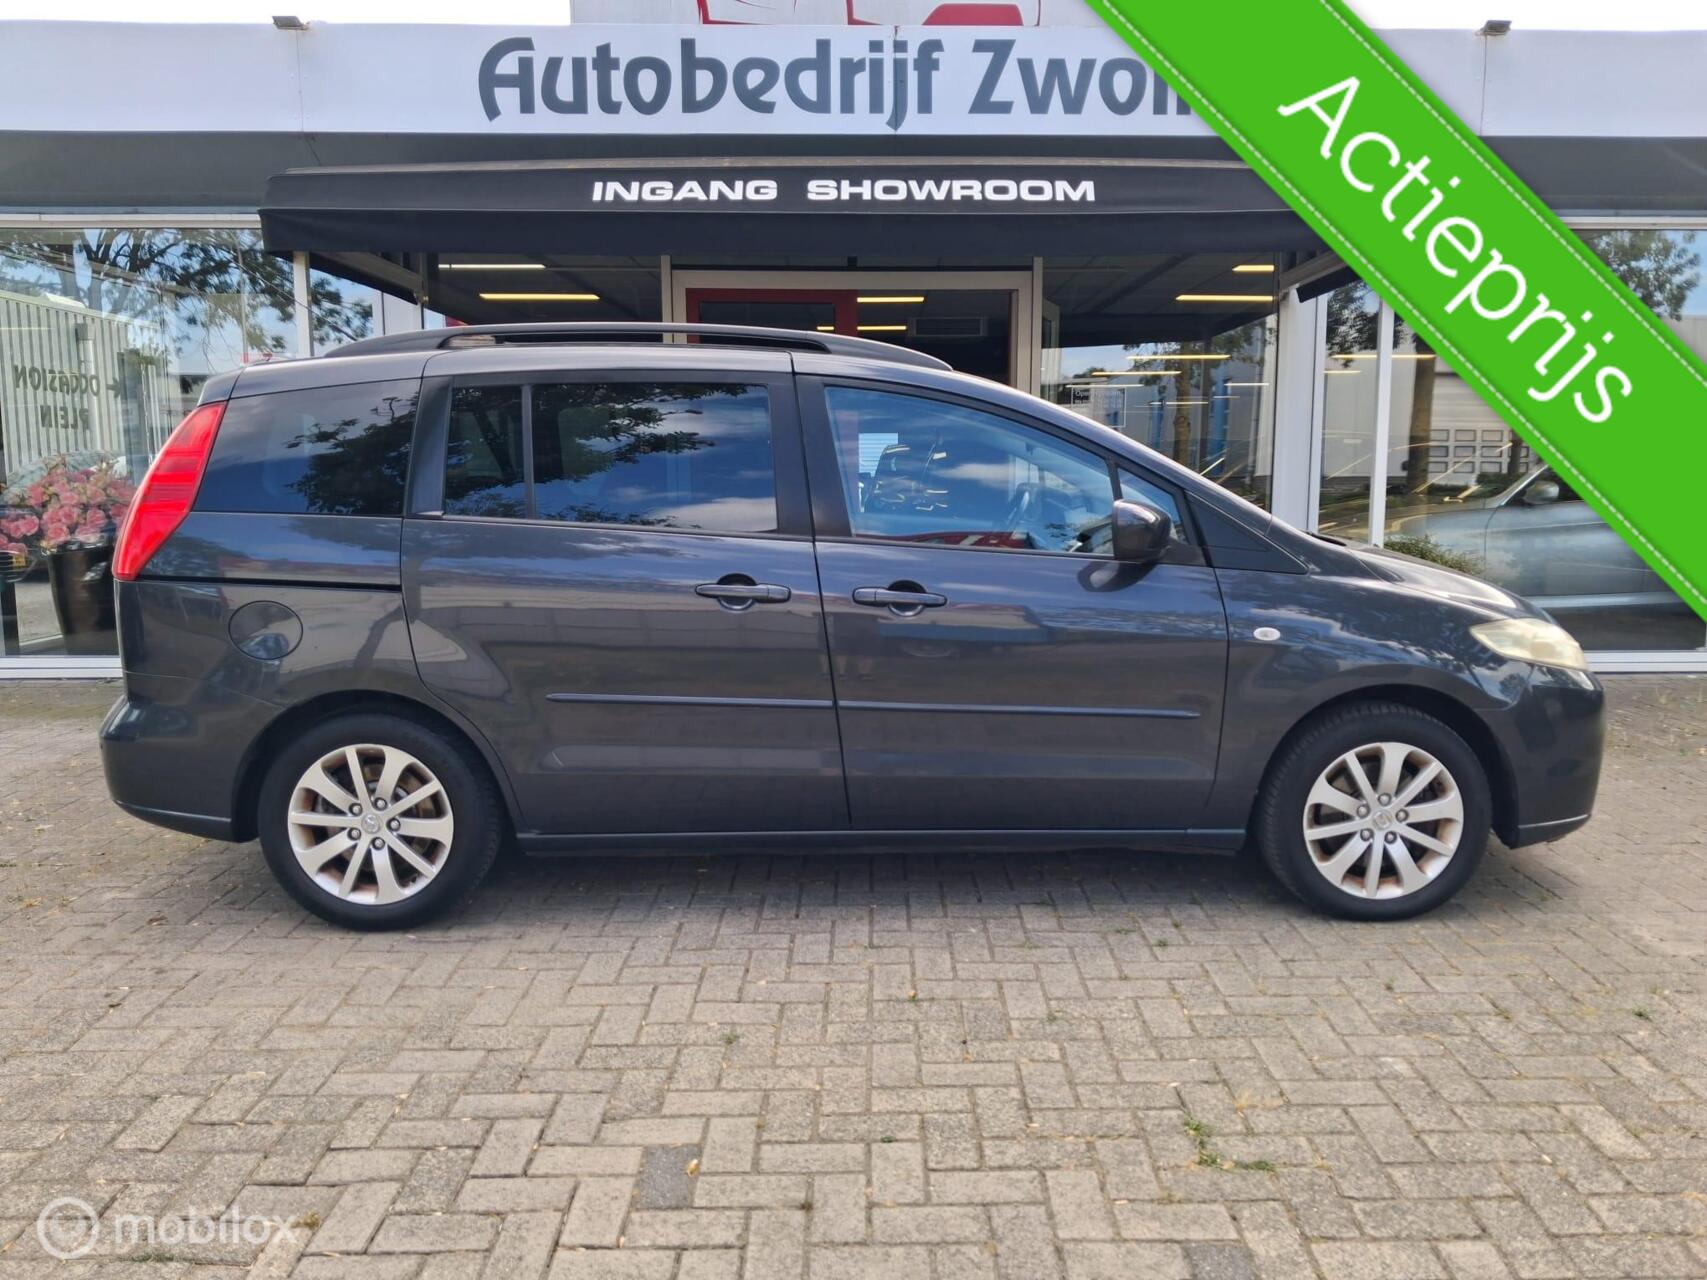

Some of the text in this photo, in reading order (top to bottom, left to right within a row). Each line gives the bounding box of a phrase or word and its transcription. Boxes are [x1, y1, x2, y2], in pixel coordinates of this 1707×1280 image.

[478, 37, 1192, 131] Autobedrijf Zwo
[592, 179, 1096, 201] INGANG SHOWROOM
